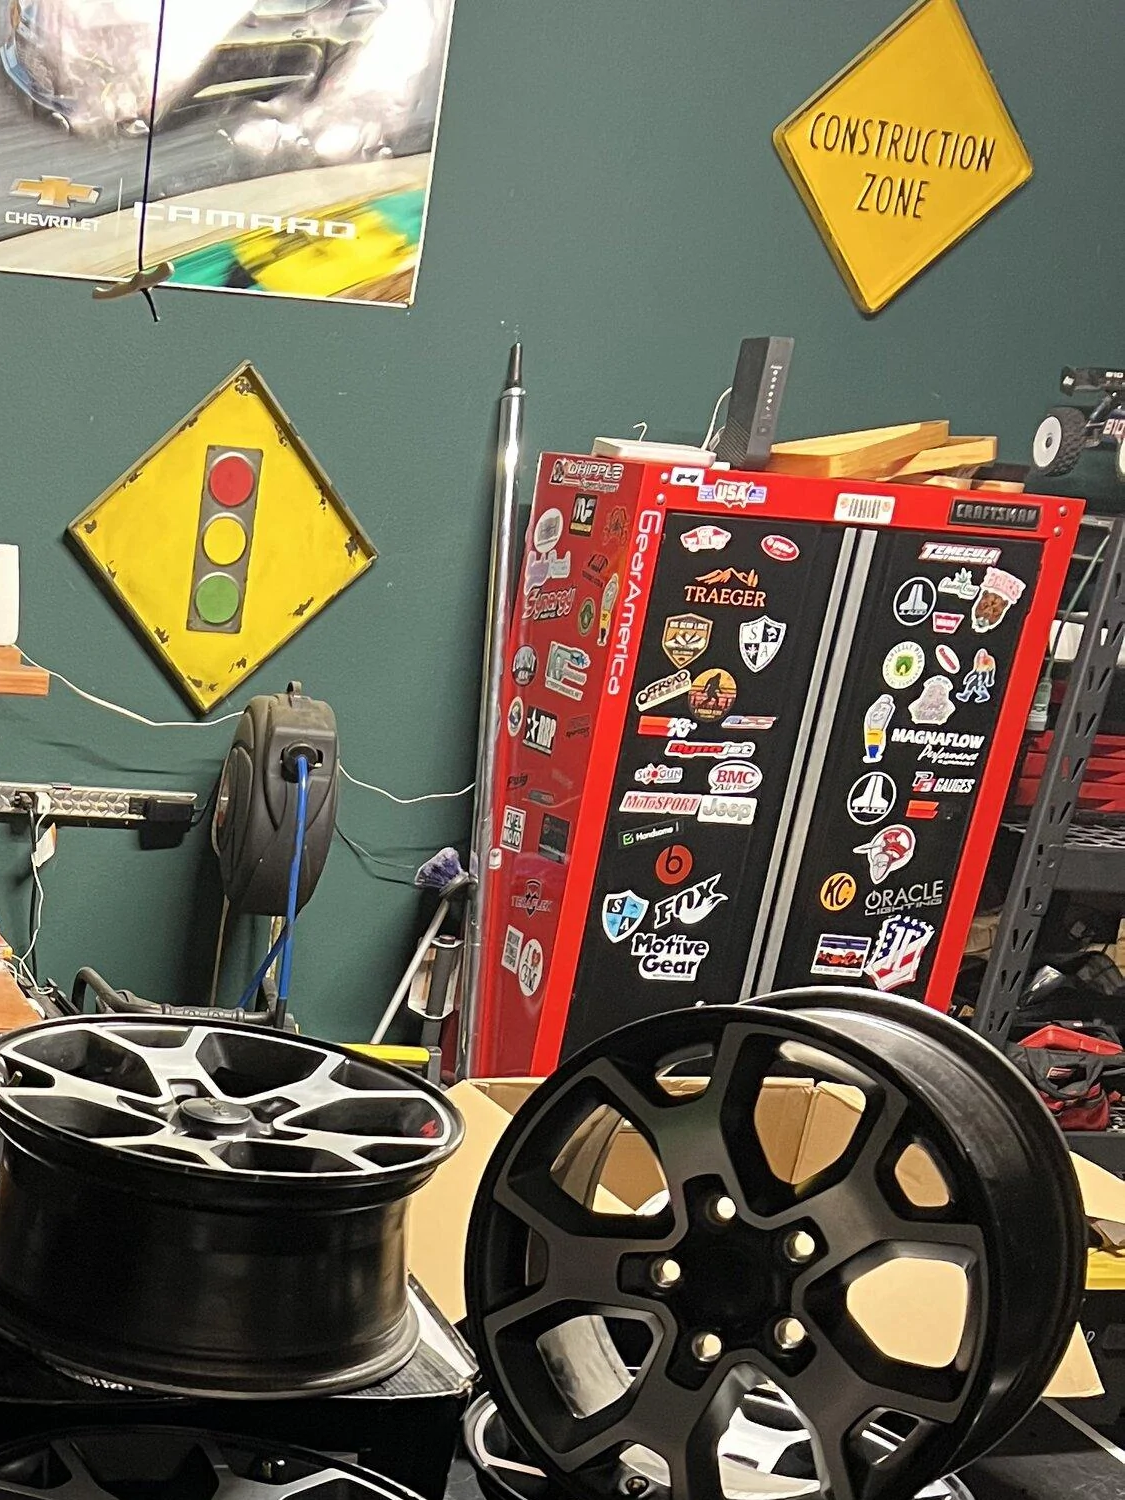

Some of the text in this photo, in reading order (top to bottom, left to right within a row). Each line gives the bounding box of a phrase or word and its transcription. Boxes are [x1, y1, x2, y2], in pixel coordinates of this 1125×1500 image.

[809, 112, 997, 173] CONSTRUCTION
[857, 172, 931, 220] ZONE
[5, 211, 100, 232] CHEVROLET
[133, 201, 356, 240] CAMARO
[567, 461, 624, 481] WHIPPLE
[717, 484, 747, 501] USA
[956, 503, 1038, 523] CRAFTSMAN
[921, 543, 999, 562] TEMECULA
[684, 585, 766, 607] TRAEGER
[891, 728, 985, 749] MAGNAFLOW
[716, 769, 755, 784] BMC
[934, 777, 975, 793] GAUGES
[702, 797, 752, 822] Jeep
[655, 878, 718, 926] FOX
[825, 875, 853, 908] KC
[865, 880, 945, 910] ORACLE
[865, 898, 943, 917] LIGHTING
[634, 934, 707, 955] Motive
[641, 954, 697, 975] Gear
